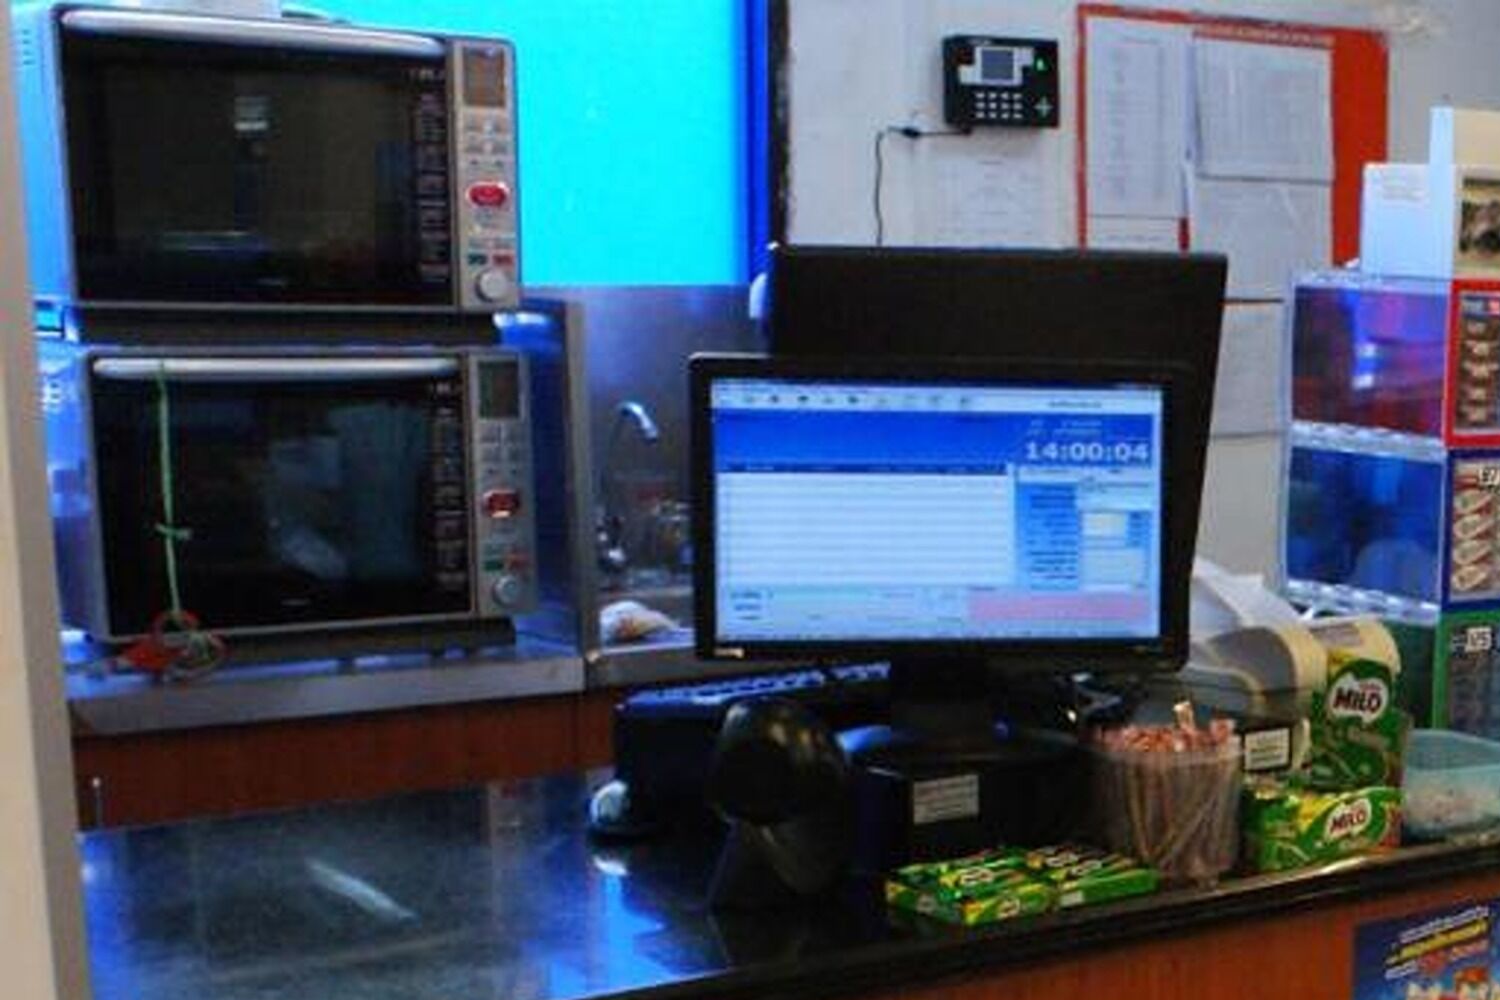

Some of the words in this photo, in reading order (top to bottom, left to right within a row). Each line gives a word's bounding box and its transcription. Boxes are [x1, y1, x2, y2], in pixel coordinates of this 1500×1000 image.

[1026, 441, 1149, 464] 14:00:04
[1332, 687, 1383, 714] MILO
[1329, 809, 1367, 835] MILO
